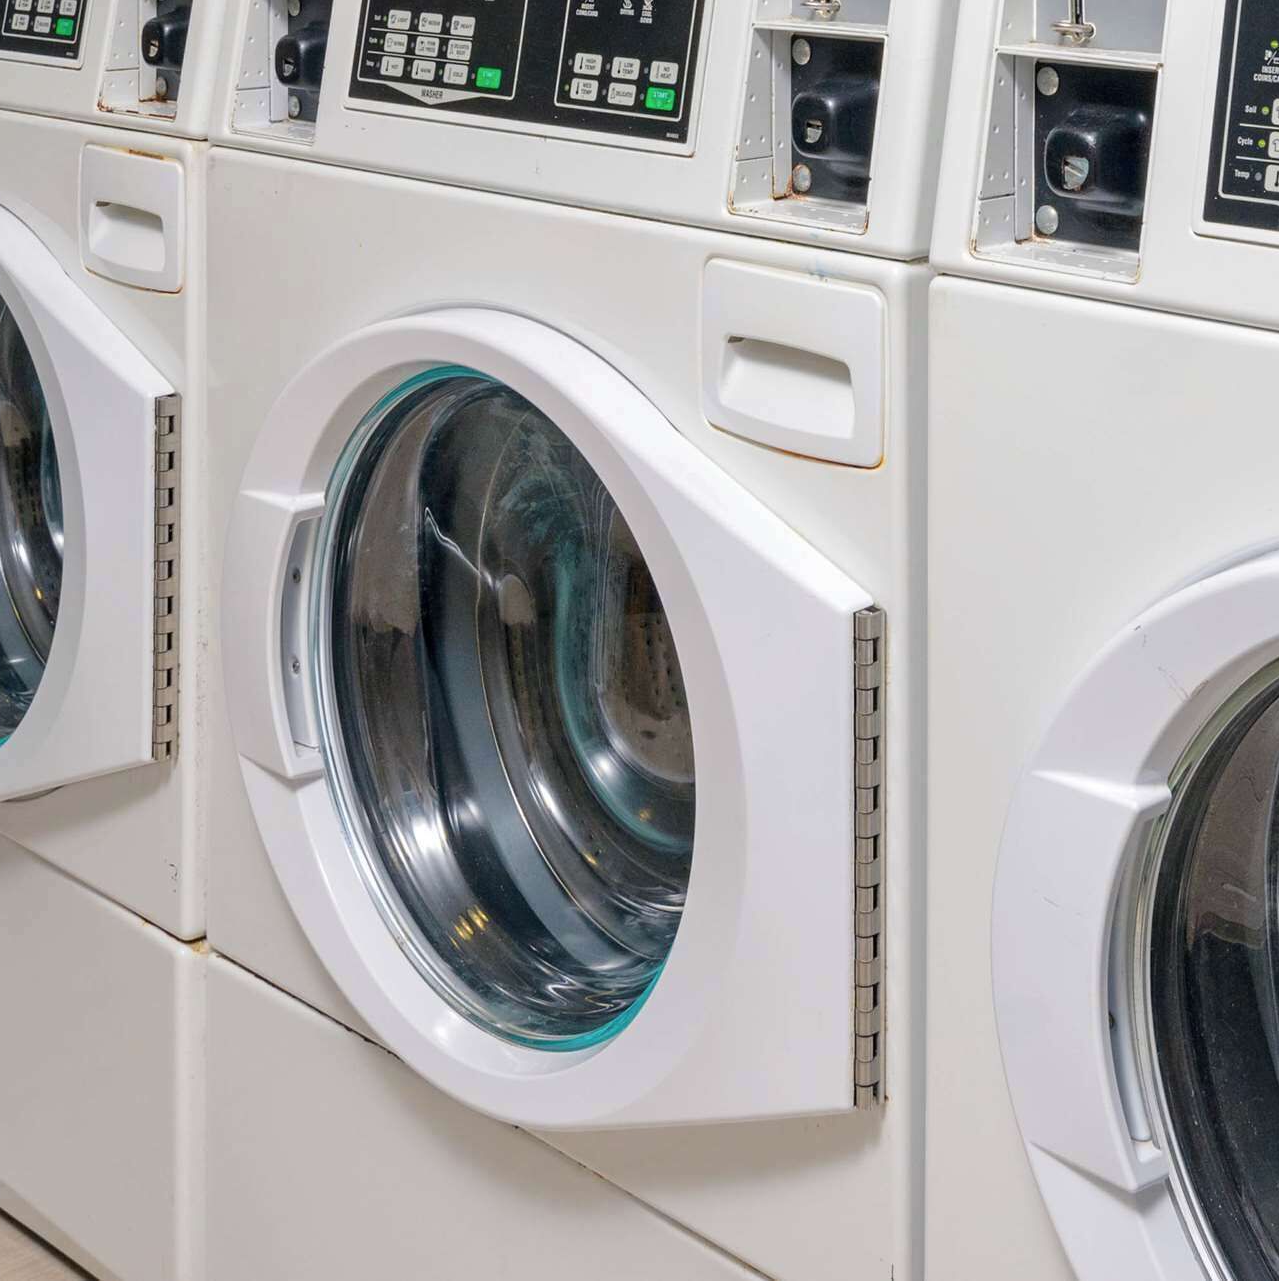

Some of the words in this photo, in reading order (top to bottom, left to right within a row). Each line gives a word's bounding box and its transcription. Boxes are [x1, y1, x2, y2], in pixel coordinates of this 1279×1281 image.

[421, 88, 443, 99] WASHER
[1244, 105, 1257, 114] Soil
[1237, 136, 1253, 147] Cycle
[1234, 169, 1250, 180] Temp
